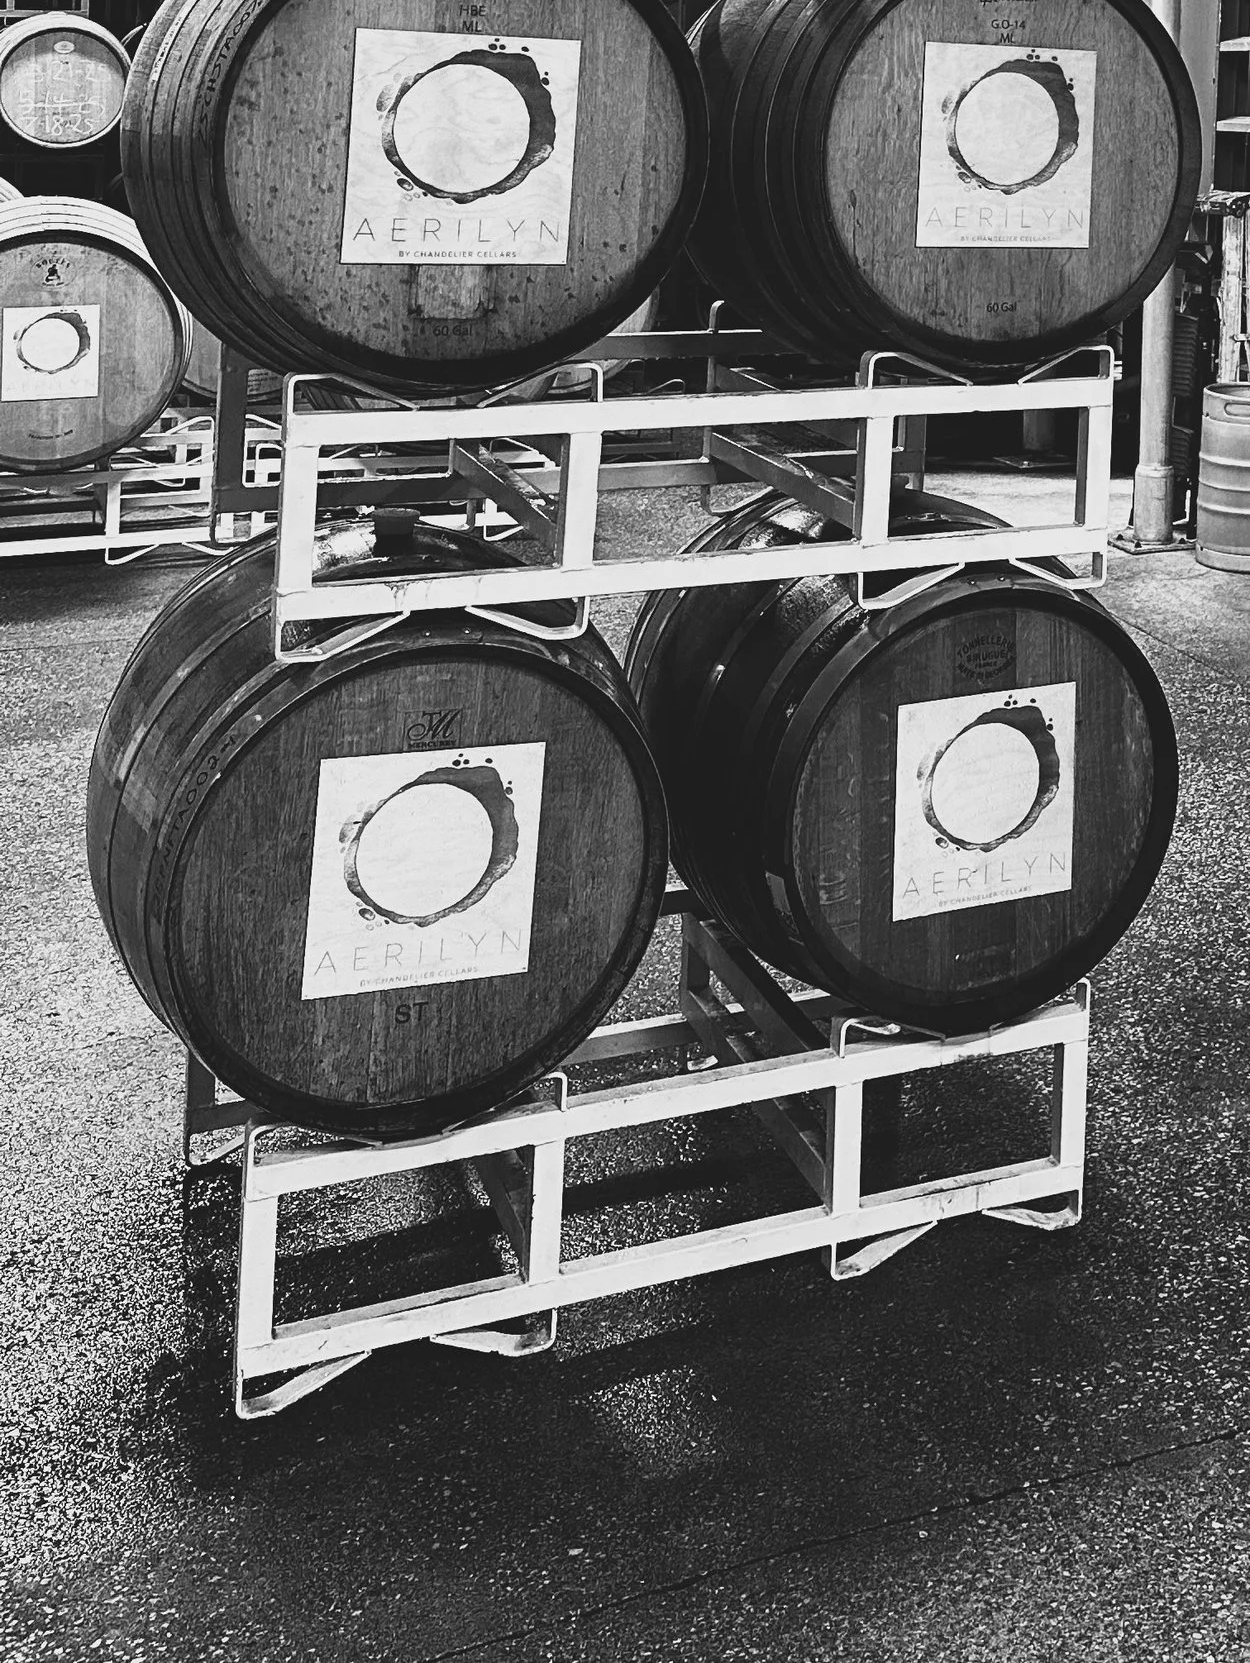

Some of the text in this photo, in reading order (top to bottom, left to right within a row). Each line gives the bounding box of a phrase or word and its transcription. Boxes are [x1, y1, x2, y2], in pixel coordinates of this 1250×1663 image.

[460, 4, 486, 17] HBE
[462, 20, 482, 33] ML
[1000, 32, 1016, 44] ML
[925, 206, 1084, 228] AERILYN
[353, 218, 559, 242] AERILYN
[986, 302, 1017, 313] 60 Gal
[433, 324, 473, 336] 60 Gal
[903, 852, 1066, 899] AERILYN
[938, 885, 1032, 908] BY CHANDELIER CELLARS
[314, 929, 522, 977] AERILYN
[360, 966, 478, 987] BY CHANDELIER CELLARS
[394, 1000, 429, 1024] ST
